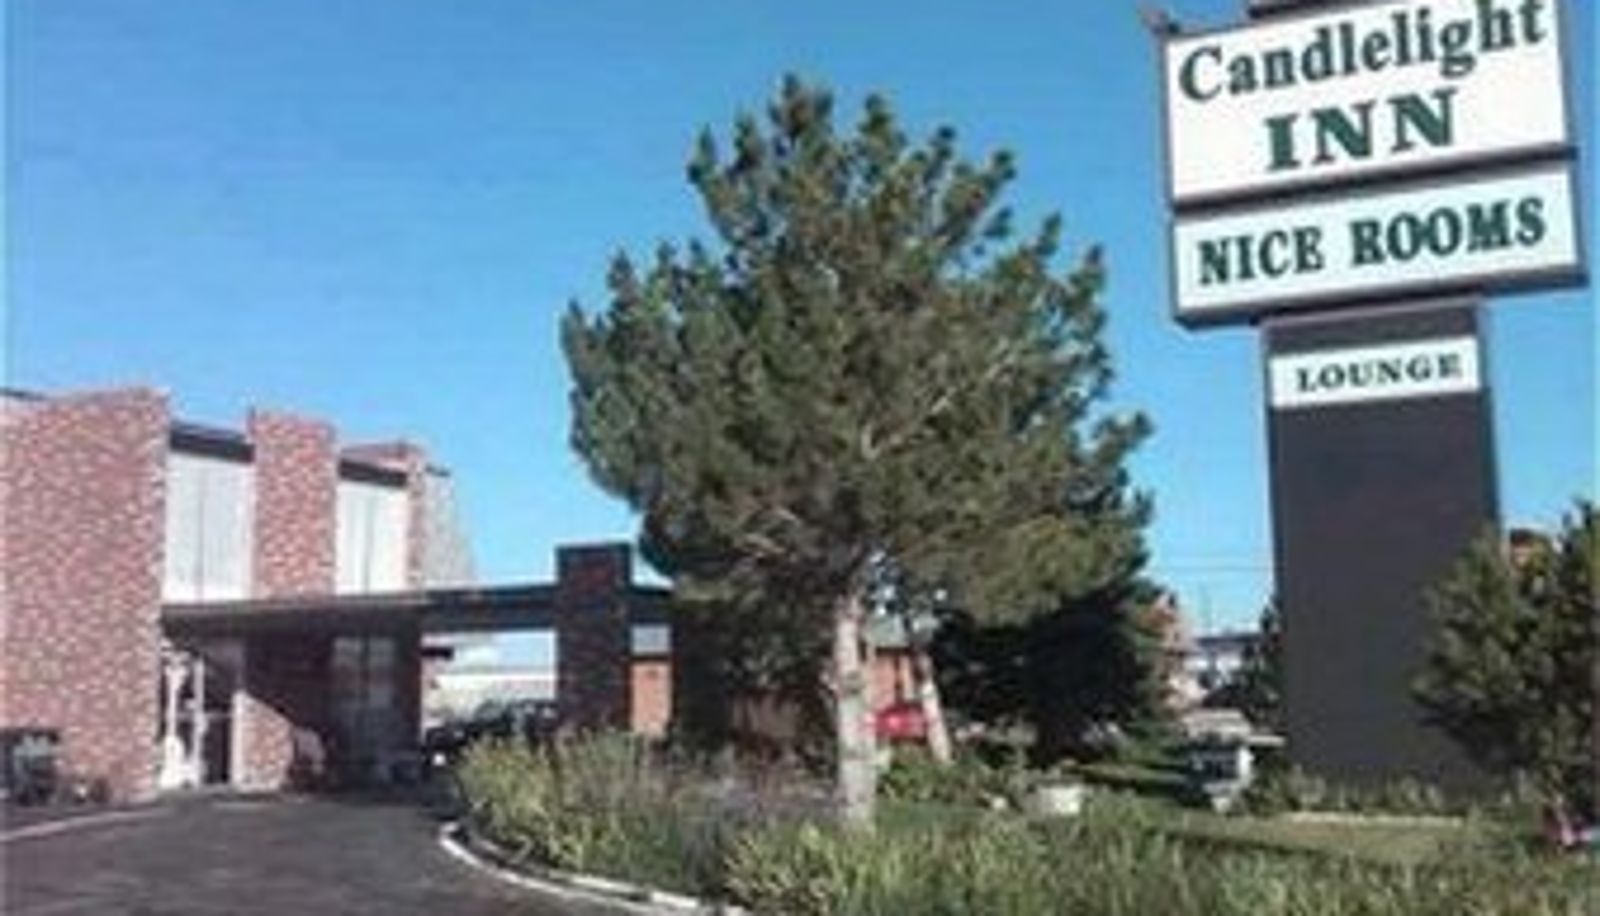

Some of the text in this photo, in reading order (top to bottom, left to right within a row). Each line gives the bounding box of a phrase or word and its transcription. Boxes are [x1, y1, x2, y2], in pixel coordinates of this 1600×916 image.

[1178, 0, 1547, 102] Candlelight
[1262, 87, 1458, 172] INN
[1197, 196, 1547, 286] NICE ROOMS
[1296, 352, 1464, 392] LOUNGE
